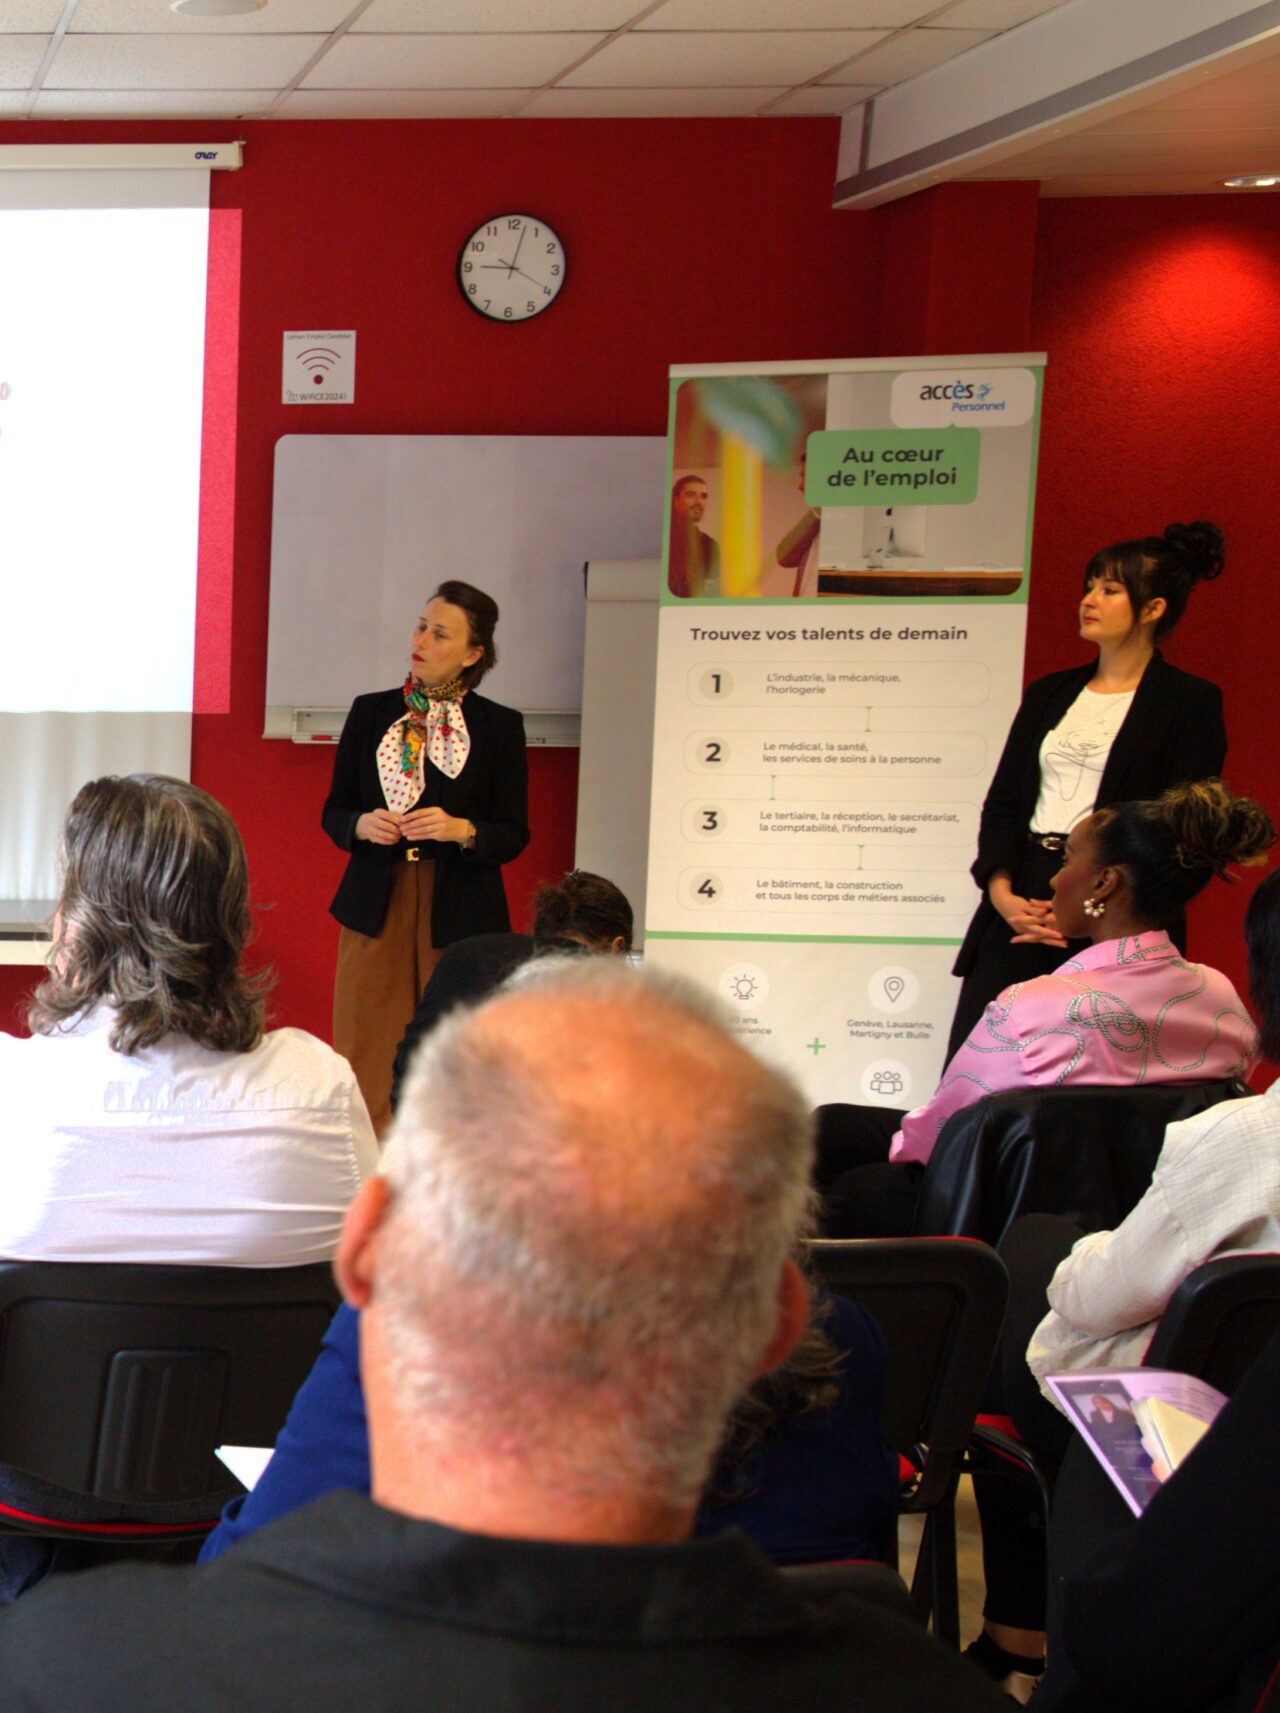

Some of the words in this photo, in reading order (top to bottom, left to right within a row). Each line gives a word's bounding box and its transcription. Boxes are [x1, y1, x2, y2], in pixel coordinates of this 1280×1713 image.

[507, 218, 521, 230] 12
[486, 225, 498, 237] 11
[471, 241, 485, 253] 10
[546, 242, 556, 254] 2
[464, 261, 473, 273] 9
[551, 264, 560, 276] 3
[468, 284, 477, 295] 8
[543, 286, 552, 296] 4
[483, 300, 491, 311] 7
[526, 301, 536, 312] 5
[504, 306, 513, 318] 6
[920, 380, 974, 400] accès
[952, 402, 1006, 412] Personnel
[842, 447, 875, 465] Au
[881, 446, 944, 463] cœur
[828, 471, 856, 487] de
[863, 467, 957, 490] l'emploi
[690, 626, 761, 641] Trouvez
[766, 629, 796, 641] vos
[801, 626, 864, 641] talents
[869, 626, 893, 640] de
[898, 626, 968, 640] demain
[712, 674, 722, 694] 1
[826, 674, 836, 682] la
[838, 674, 901, 684] mécanique,
[705, 743, 721, 763] 2
[764, 742, 776, 751] Le
[778, 742, 824, 752] médical,
[826, 742, 835, 751] la
[837, 742, 869, 752] santé,
[763, 754, 778, 763] les
[780, 755, 821, 763] services
[824, 755, 838, 763] de
[840, 755, 867, 764] soins
[869, 755, 876, 764] à
[879, 755, 888, 764] la
[890, 756, 942, 765] personne
[702, 810, 718, 831] 3
[760, 812, 773, 820] Le
[775, 812, 819, 822] tertiaire,
[821, 812, 830, 821] la
[833, 812, 886, 823] réception,
[888, 813, 898, 821] le
[900, 813, 960, 823] secrétariat,
[759, 823, 768, 832] la
[771, 823, 840, 834] comptabilité,
[697, 878, 716, 898] 4
[756, 880, 769, 888] Le
[771, 880, 822, 890] bâtiment,
[825, 880, 834, 889] la
[836, 881, 903, 890] construction
[756, 892, 766, 900] et
[769, 892, 792, 901] tous
[794, 892, 809, 901] les
[811, 894, 840, 902] corps
[842, 893, 856, 901] de
[858, 893, 899, 902] métiers
[901, 894, 945, 903] associés
[847, 1019, 884, 1028] Genève,
[887, 1021, 934, 1030] Lausanne,
[850, 1030, 892, 1040] Martigny
[894, 1031, 904, 1039] et
[906, 1031, 930, 1039] Bulle
